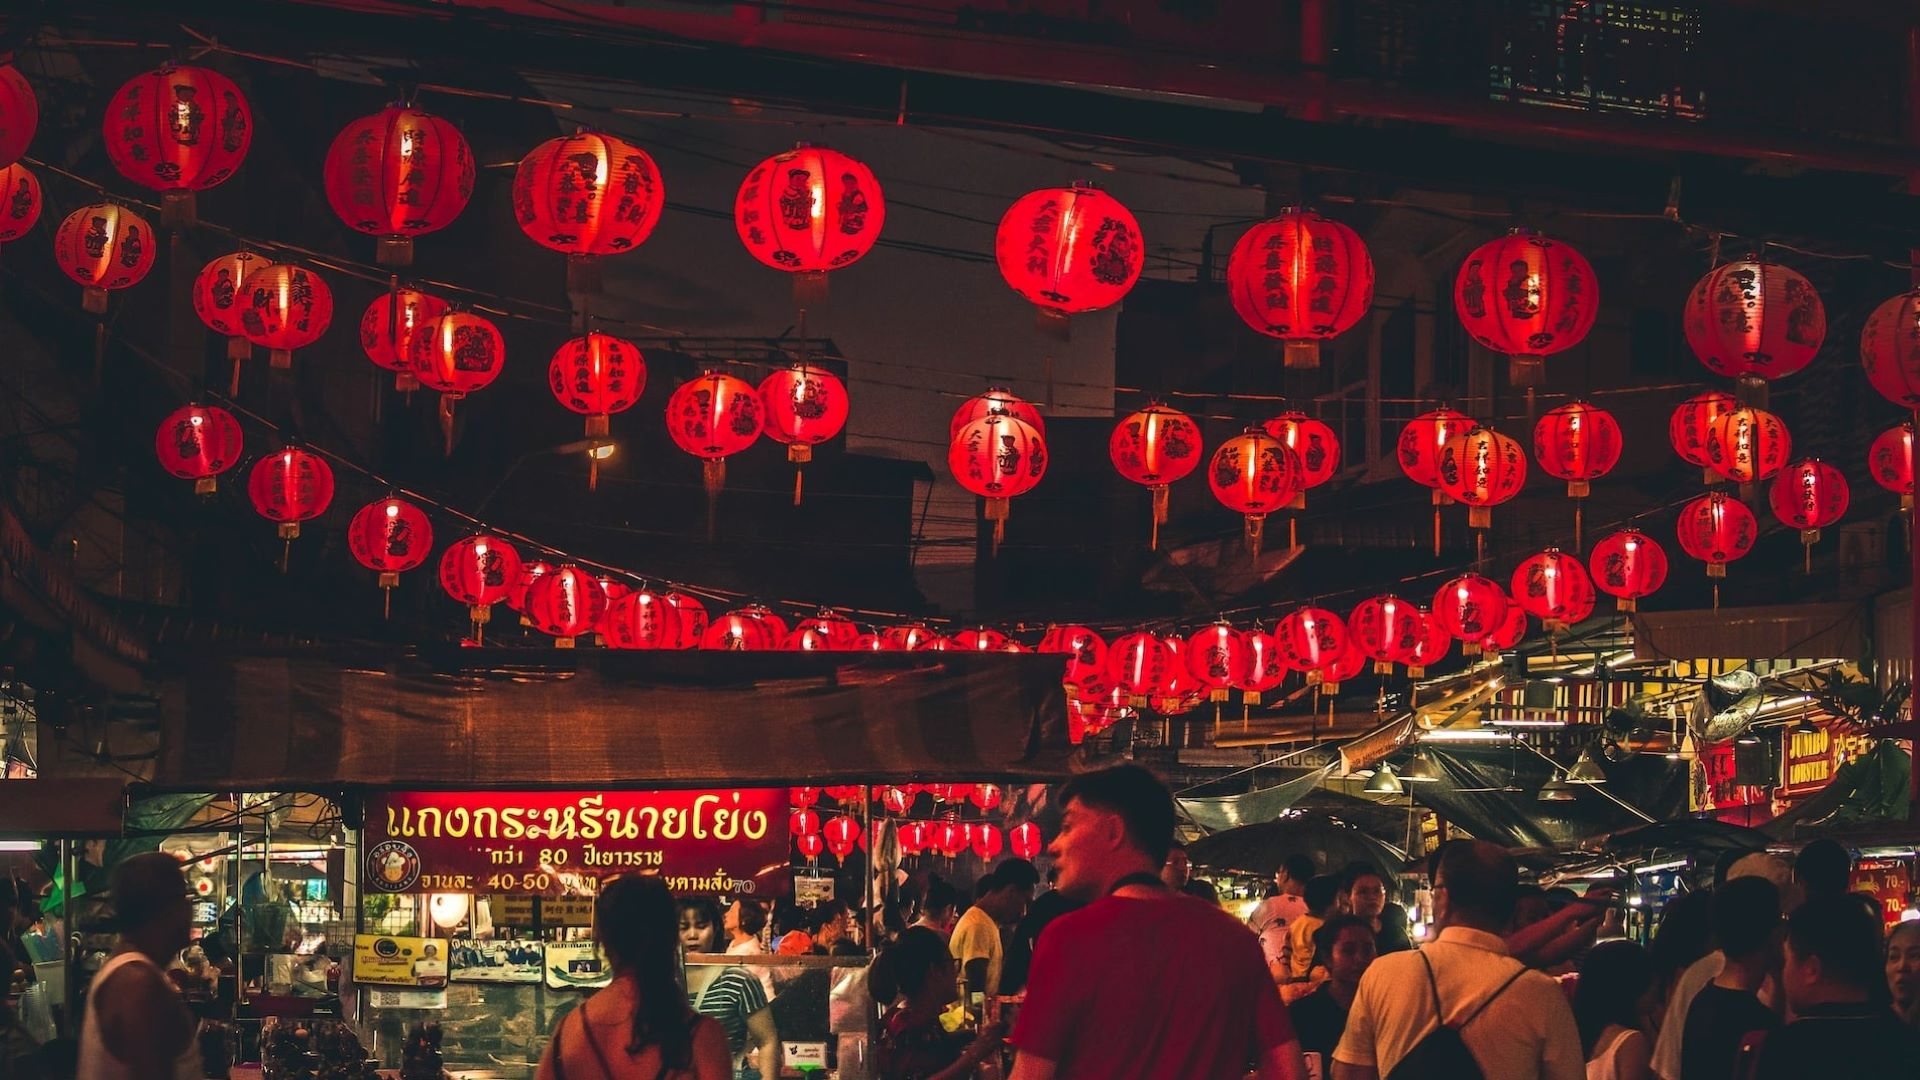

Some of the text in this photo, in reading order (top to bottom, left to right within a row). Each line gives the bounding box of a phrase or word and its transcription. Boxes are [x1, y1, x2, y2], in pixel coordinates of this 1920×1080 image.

[1789, 728, 1829, 759] JUMBO
[1789, 760, 1829, 785] LOBSTER
[490, 843, 663, 866] กว่า 80 ปีเยาวราช
[421, 873, 474, 890] จานละ
[487, 873, 550, 890] 40-50
[732, 879, 756, 894] 70
[1886, 898, 1906, 912] 70.-
